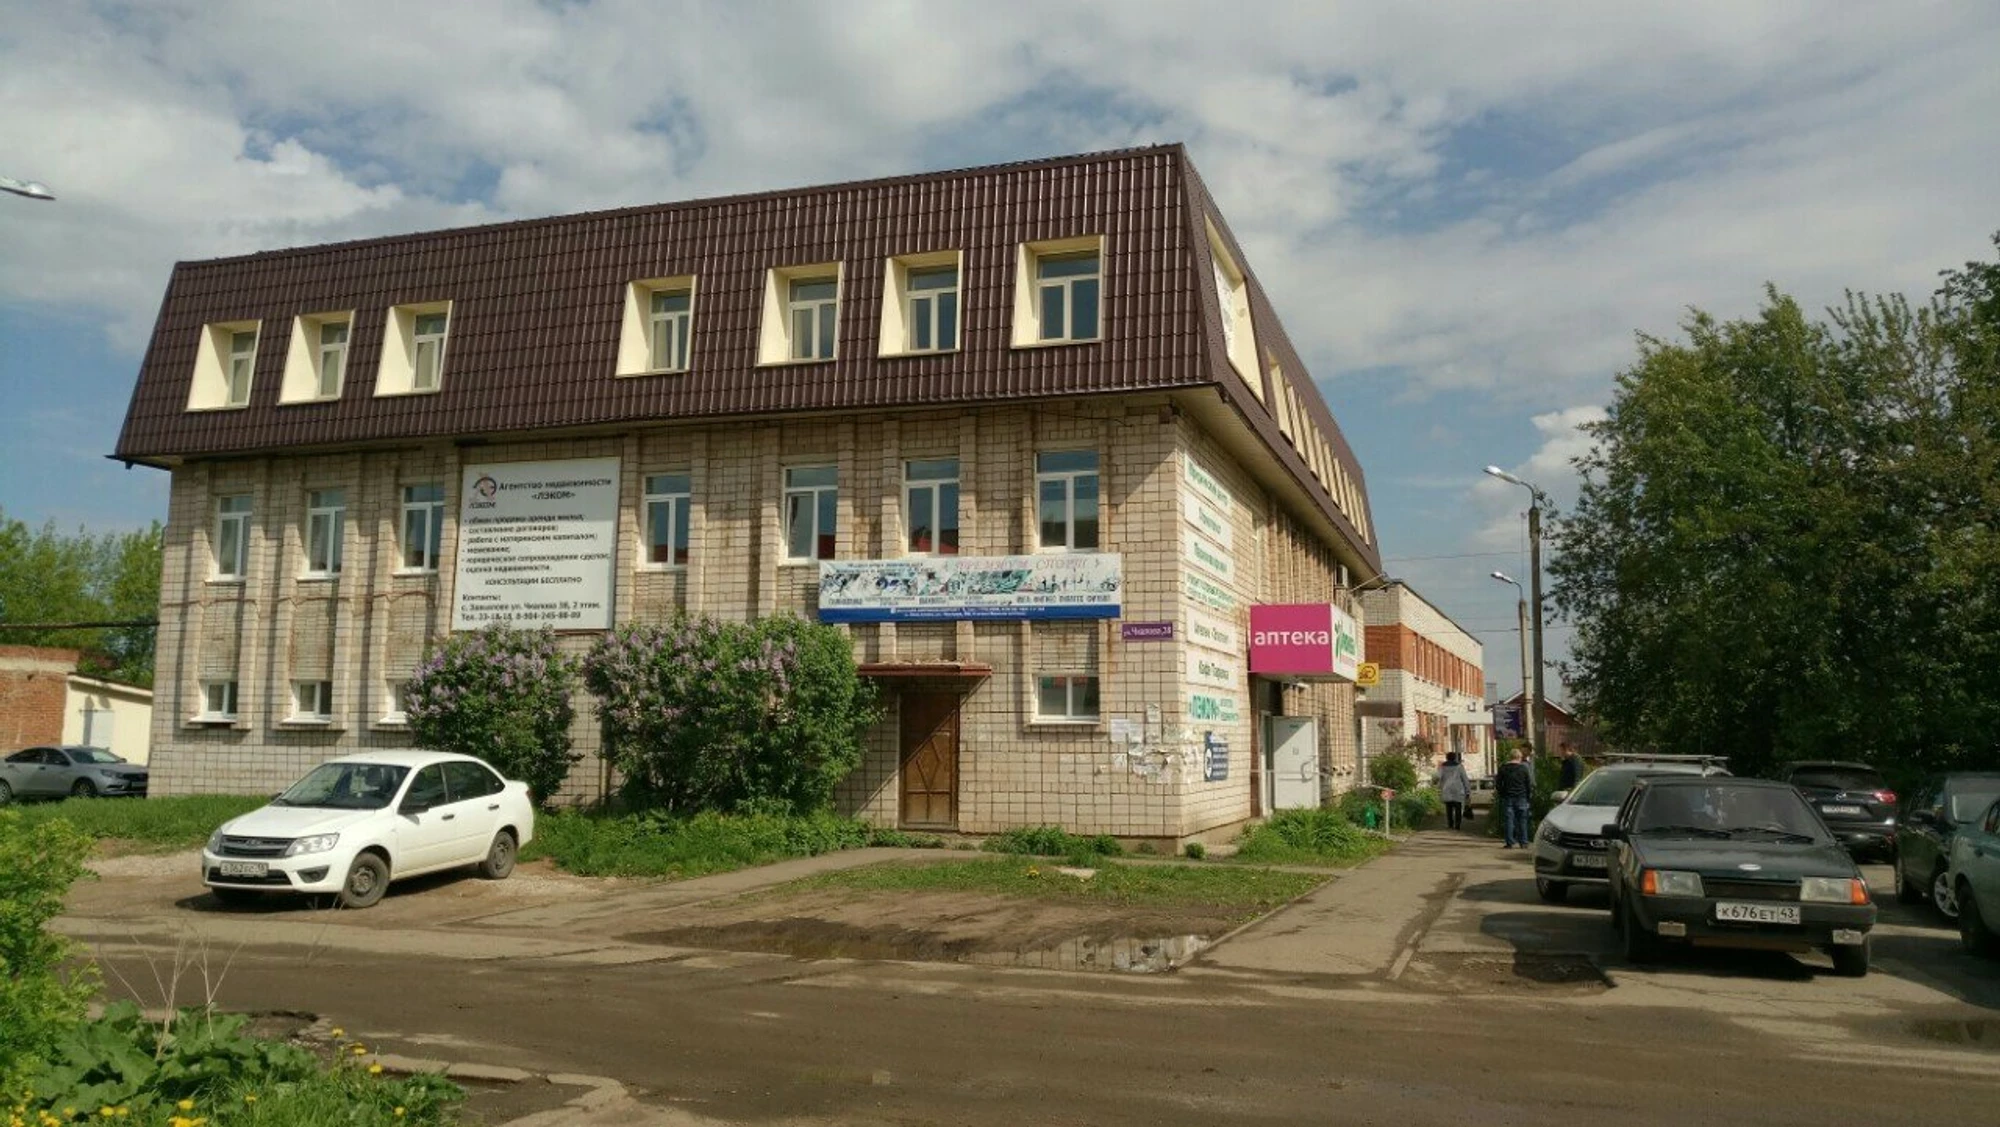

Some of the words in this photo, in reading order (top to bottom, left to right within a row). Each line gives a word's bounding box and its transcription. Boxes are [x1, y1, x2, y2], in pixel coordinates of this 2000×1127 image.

[499, 481, 542, 491] Агентство
[545, 478, 611, 488] недвижимости
[541, 576, 582, 584] БЕСПЛАТНО
[572, 601, 578, 609] 2
[1254, 631, 1329, 646] аптека
[1780, 908, 1795, 918] 43
